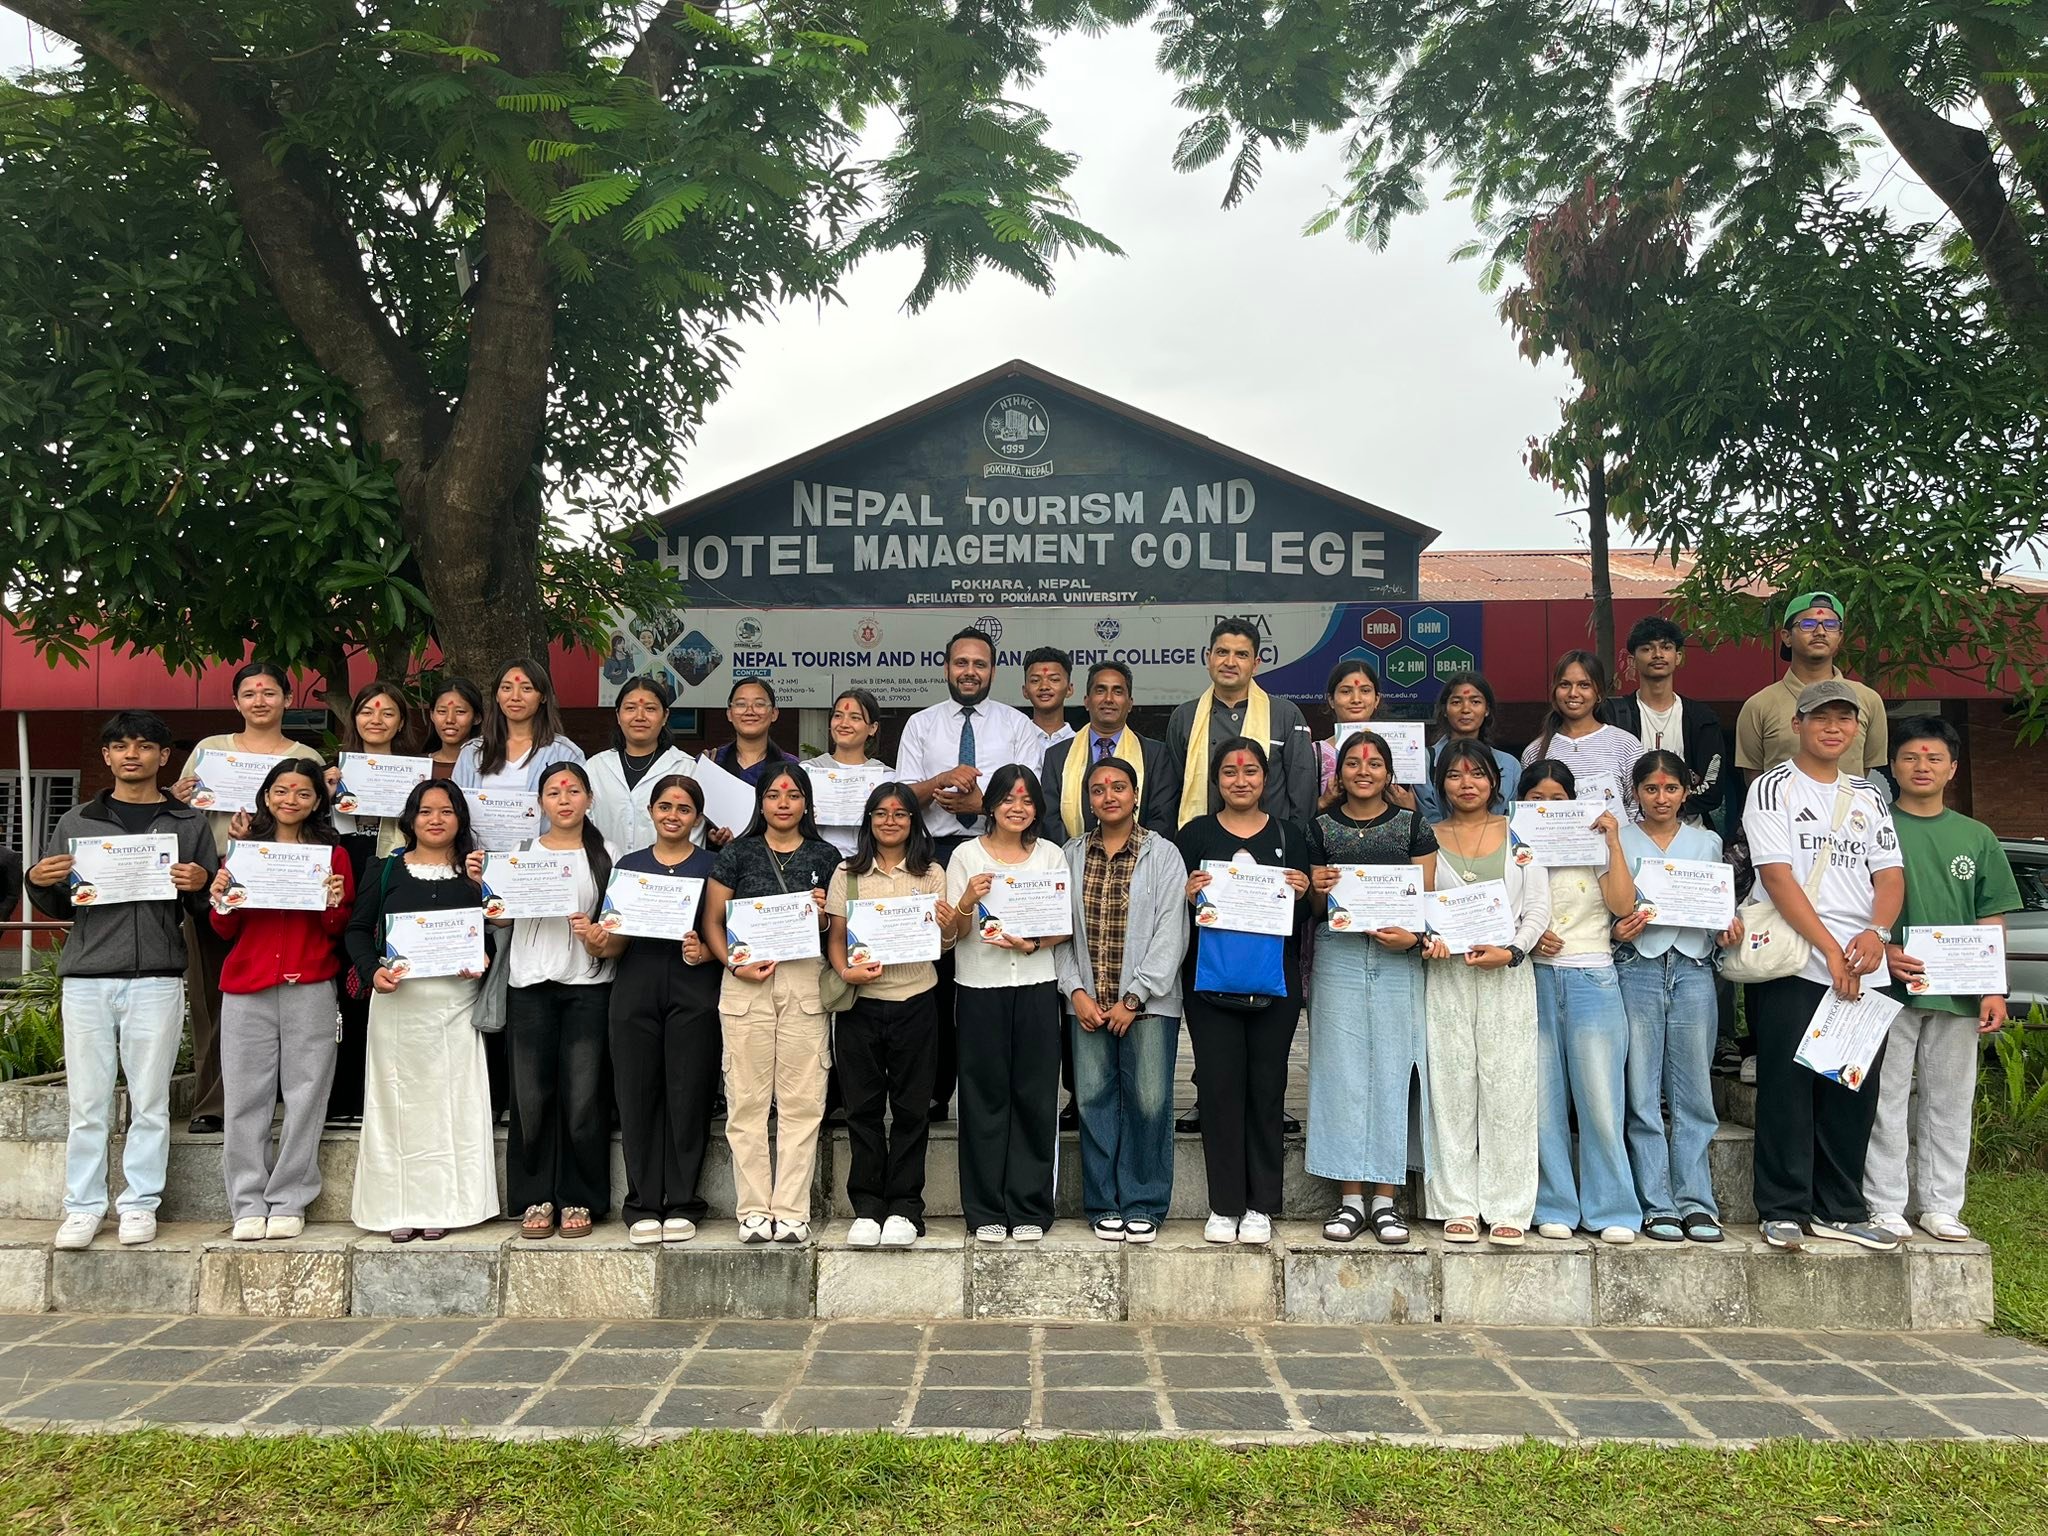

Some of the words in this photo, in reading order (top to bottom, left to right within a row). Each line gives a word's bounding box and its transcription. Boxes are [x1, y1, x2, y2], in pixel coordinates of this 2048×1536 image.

[1000, 397, 1034, 410] NTHMC
[1001, 444, 1025, 454] 1999
[1025, 465, 1050, 477] NEPAL
[793, 480, 943, 527] NEPAL
[966, 491, 1144, 525] TOURISM
[1160, 478, 1256, 524] AND
[657, 535, 834, 581] HOTEL
[854, 533, 1114, 572] MANAGEMENT
[1131, 531, 1385, 580] COLLEGE
[1038, 578, 1091, 589] NEPAL
[907, 593, 975, 603] AFFILIATED
[979, 593, 994, 603] TO
[1000, 592, 1057, 603] POKHARA
[1063, 591, 1138, 602] UNIVERSITY
[1367, 622, 1397, 635] EMBA
[1417, 622, 1441, 634] BHM
[733, 651, 787, 667] NEPAL
[792, 651, 871, 667] TOURISM
[877, 651, 916, 667] AND
[1113, 648, 1195, 665] COLLEGE
[1389, 660, 1405, 672] +2
[1407, 660, 1425, 672] HM
[107, 845, 156, 855] CERTIFICATE
[263, 853, 310, 862] CERTIFICATE
[513, 861, 558, 870] CERTIFICATE
[1232, 873, 1276, 884] CERTIFICATE
[1360, 875, 1403, 883] CERTIFICATE
[1669, 870, 1715, 880] CERTIFICATE
[641, 883, 683, 893] CERTIFICATE
[1010, 880, 1052, 889] CERTIFICATE
[758, 903, 799, 914] CERTIFICATE
[879, 906, 921, 916] CERTIFICATE
[421, 919, 465, 929] CERTIFICATE
